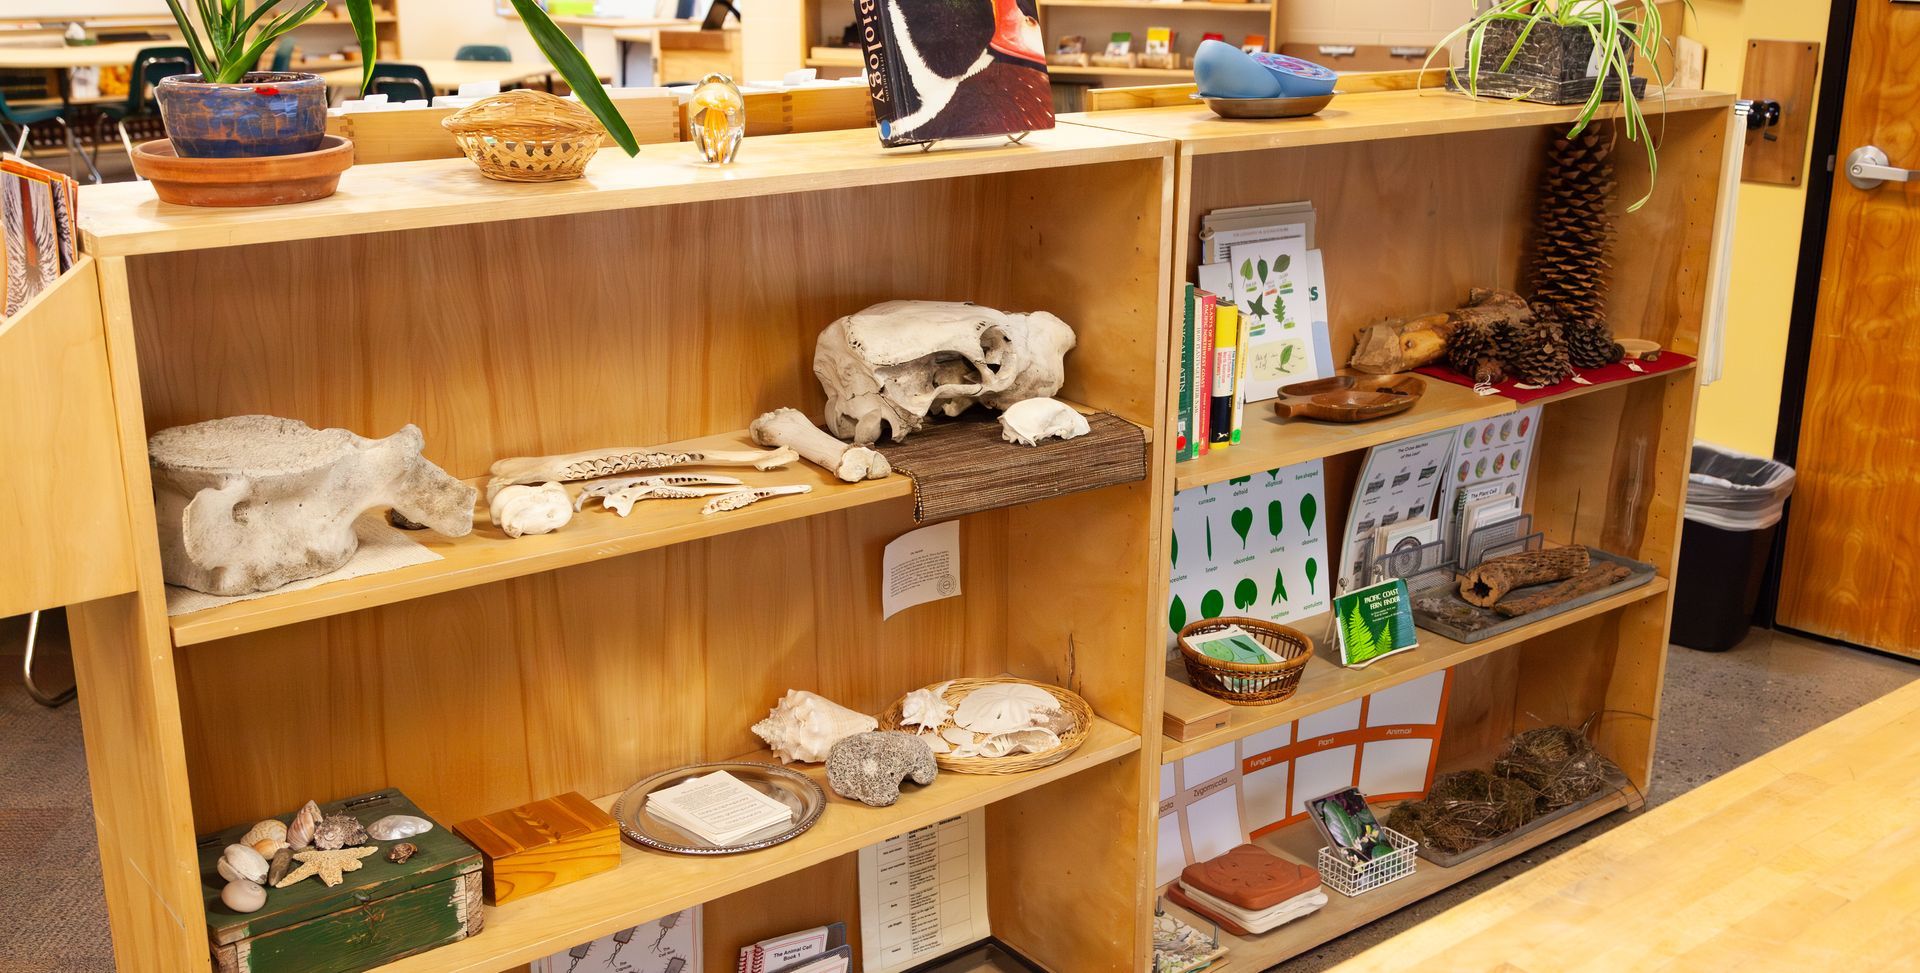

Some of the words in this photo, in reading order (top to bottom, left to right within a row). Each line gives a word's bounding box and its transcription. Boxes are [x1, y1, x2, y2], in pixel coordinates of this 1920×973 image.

[859, 0, 886, 103] Biology
[1309, 286, 1319, 301] S
[1265, 479, 1283, 488] elliptical
[1233, 488, 1248, 497] deltoid
[1198, 496, 1216, 506] cuneate
[1270, 545, 1285, 554] oblong
[1233, 554, 1256, 565] obcordate
[1205, 565, 1218, 573] linear
[1364, 593, 1382, 604] PACIFIC
[1382, 588, 1399, 598] COAST
[1303, 600, 1323, 610] spatulate
[1369, 601, 1383, 610] FERN
[1383, 596, 1401, 606] FINDER
[1386, 728, 1412, 736] Animal
[1318, 737, 1335, 747] Plant
[1250, 756, 1272, 768] Fungus
[1193, 776, 1228, 798] Zygomycota
[784, 946, 802, 955] Animal
